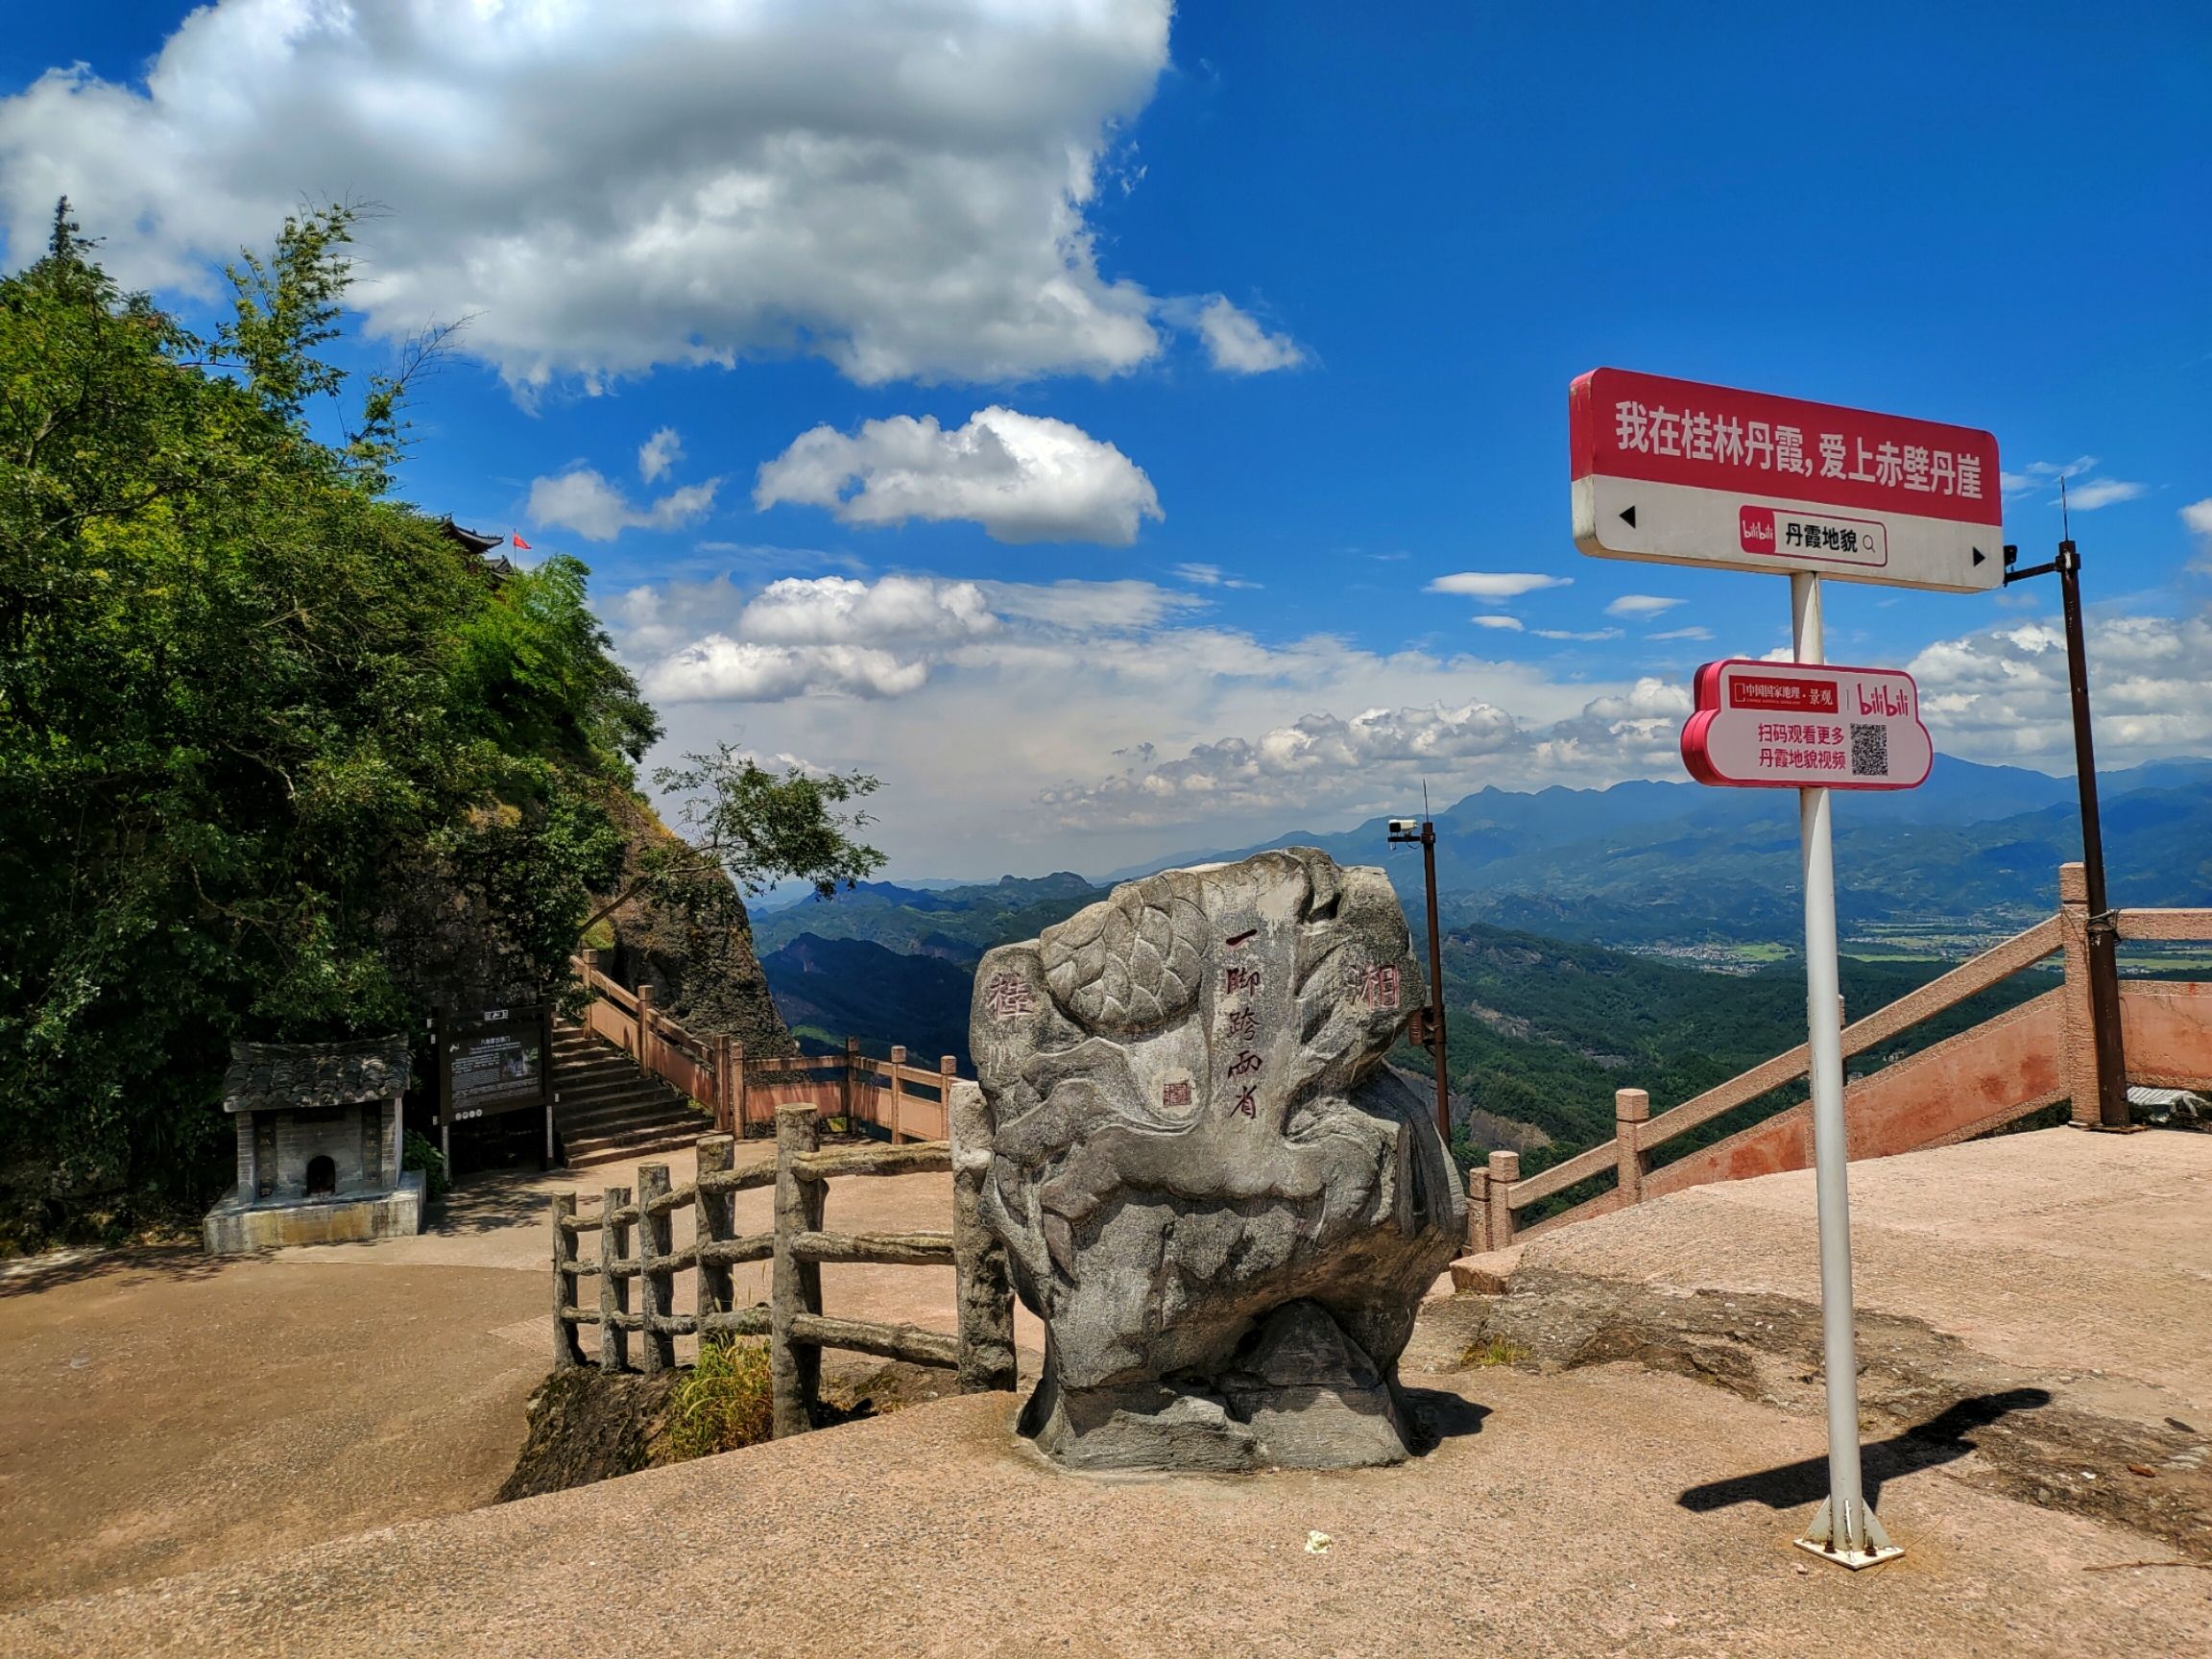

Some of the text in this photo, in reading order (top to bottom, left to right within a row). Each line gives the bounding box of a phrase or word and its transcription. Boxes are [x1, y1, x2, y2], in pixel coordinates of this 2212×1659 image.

[1615, 400, 1983, 499] 我在桂林丹霞，爱上赤壁丹崖
[1742, 519, 1773, 541] bilibili
[1785, 522, 1859, 553] 丹霞地貌
[1857, 683, 1910, 717] bilibili
[1758, 722, 1845, 745] 扫码观看更多
[1758, 748, 1846, 771] 丹霞地貌视频
